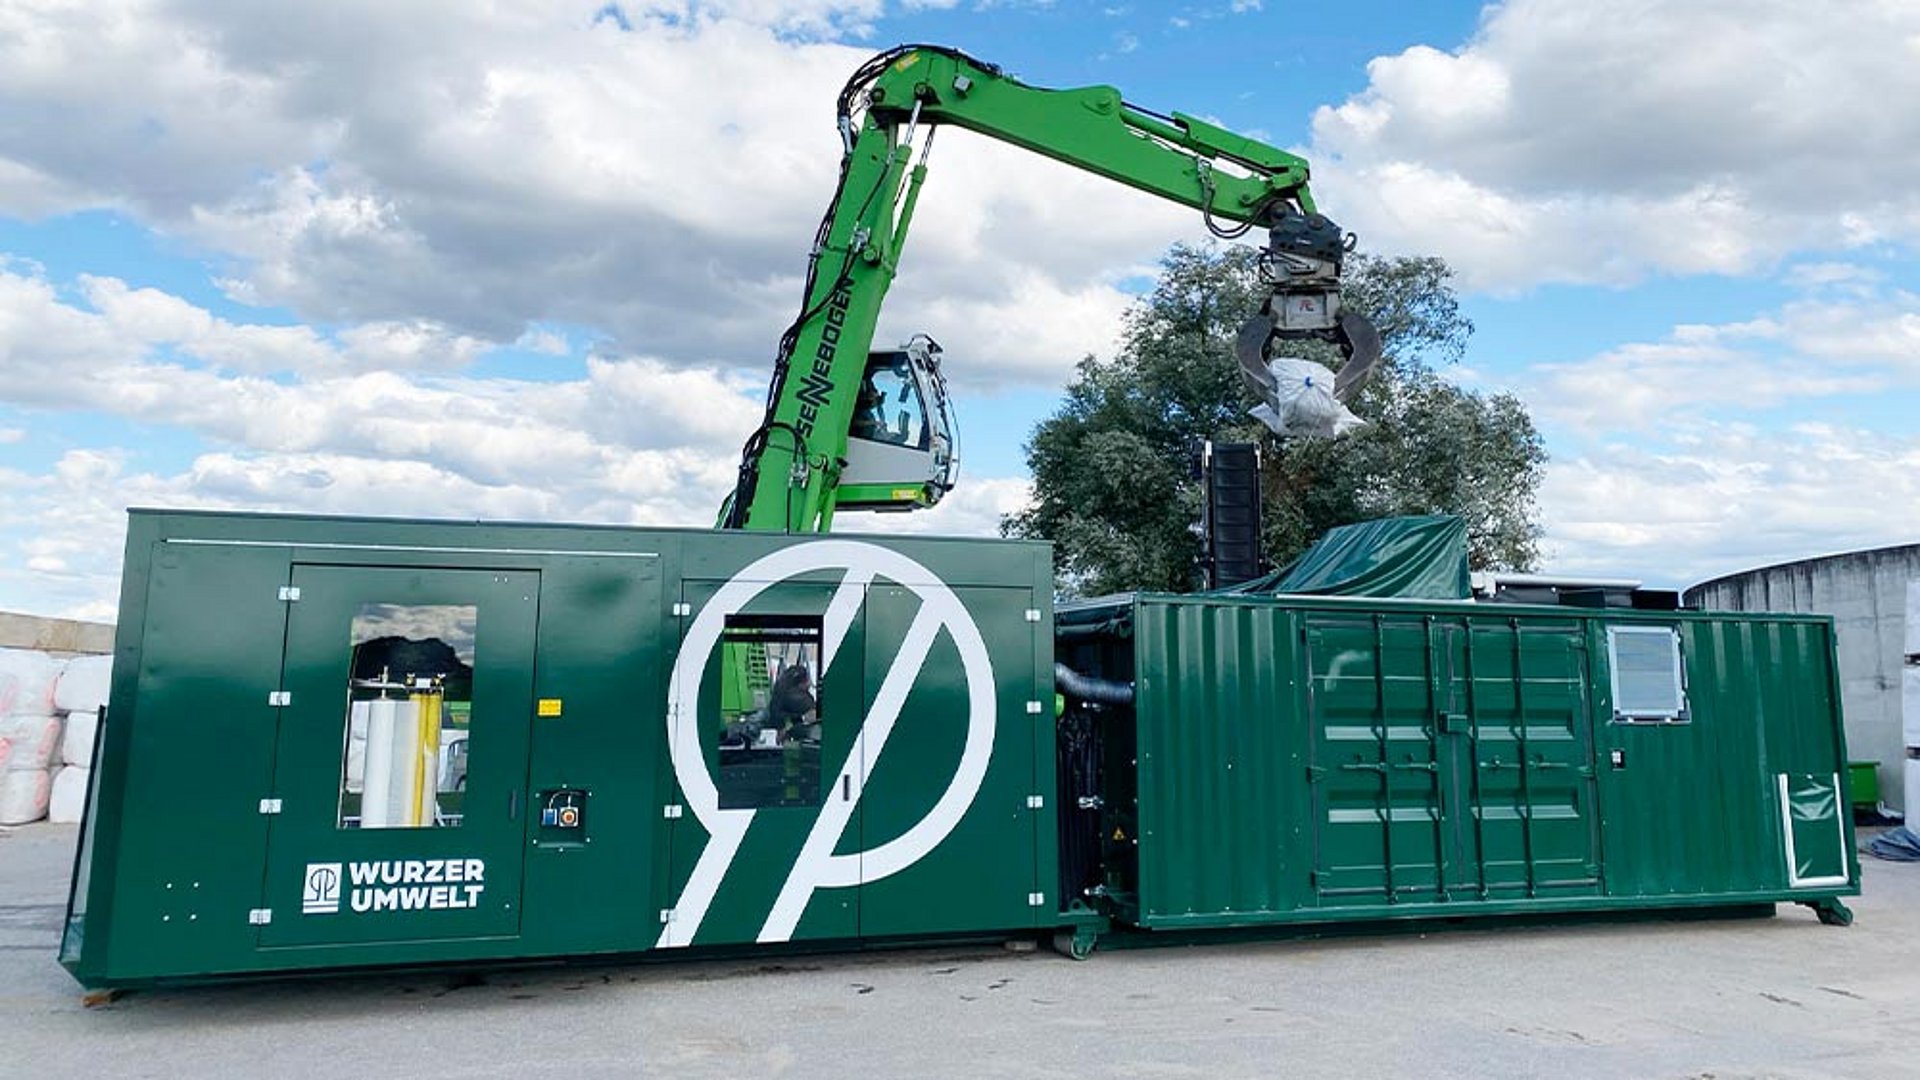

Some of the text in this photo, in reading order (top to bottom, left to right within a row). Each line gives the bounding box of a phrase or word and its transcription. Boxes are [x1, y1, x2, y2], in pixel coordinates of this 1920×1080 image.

[796, 277, 855, 438] SENNEBOGEN
[349, 859, 485, 885] WURZER
[351, 885, 485, 912] UMWELT
